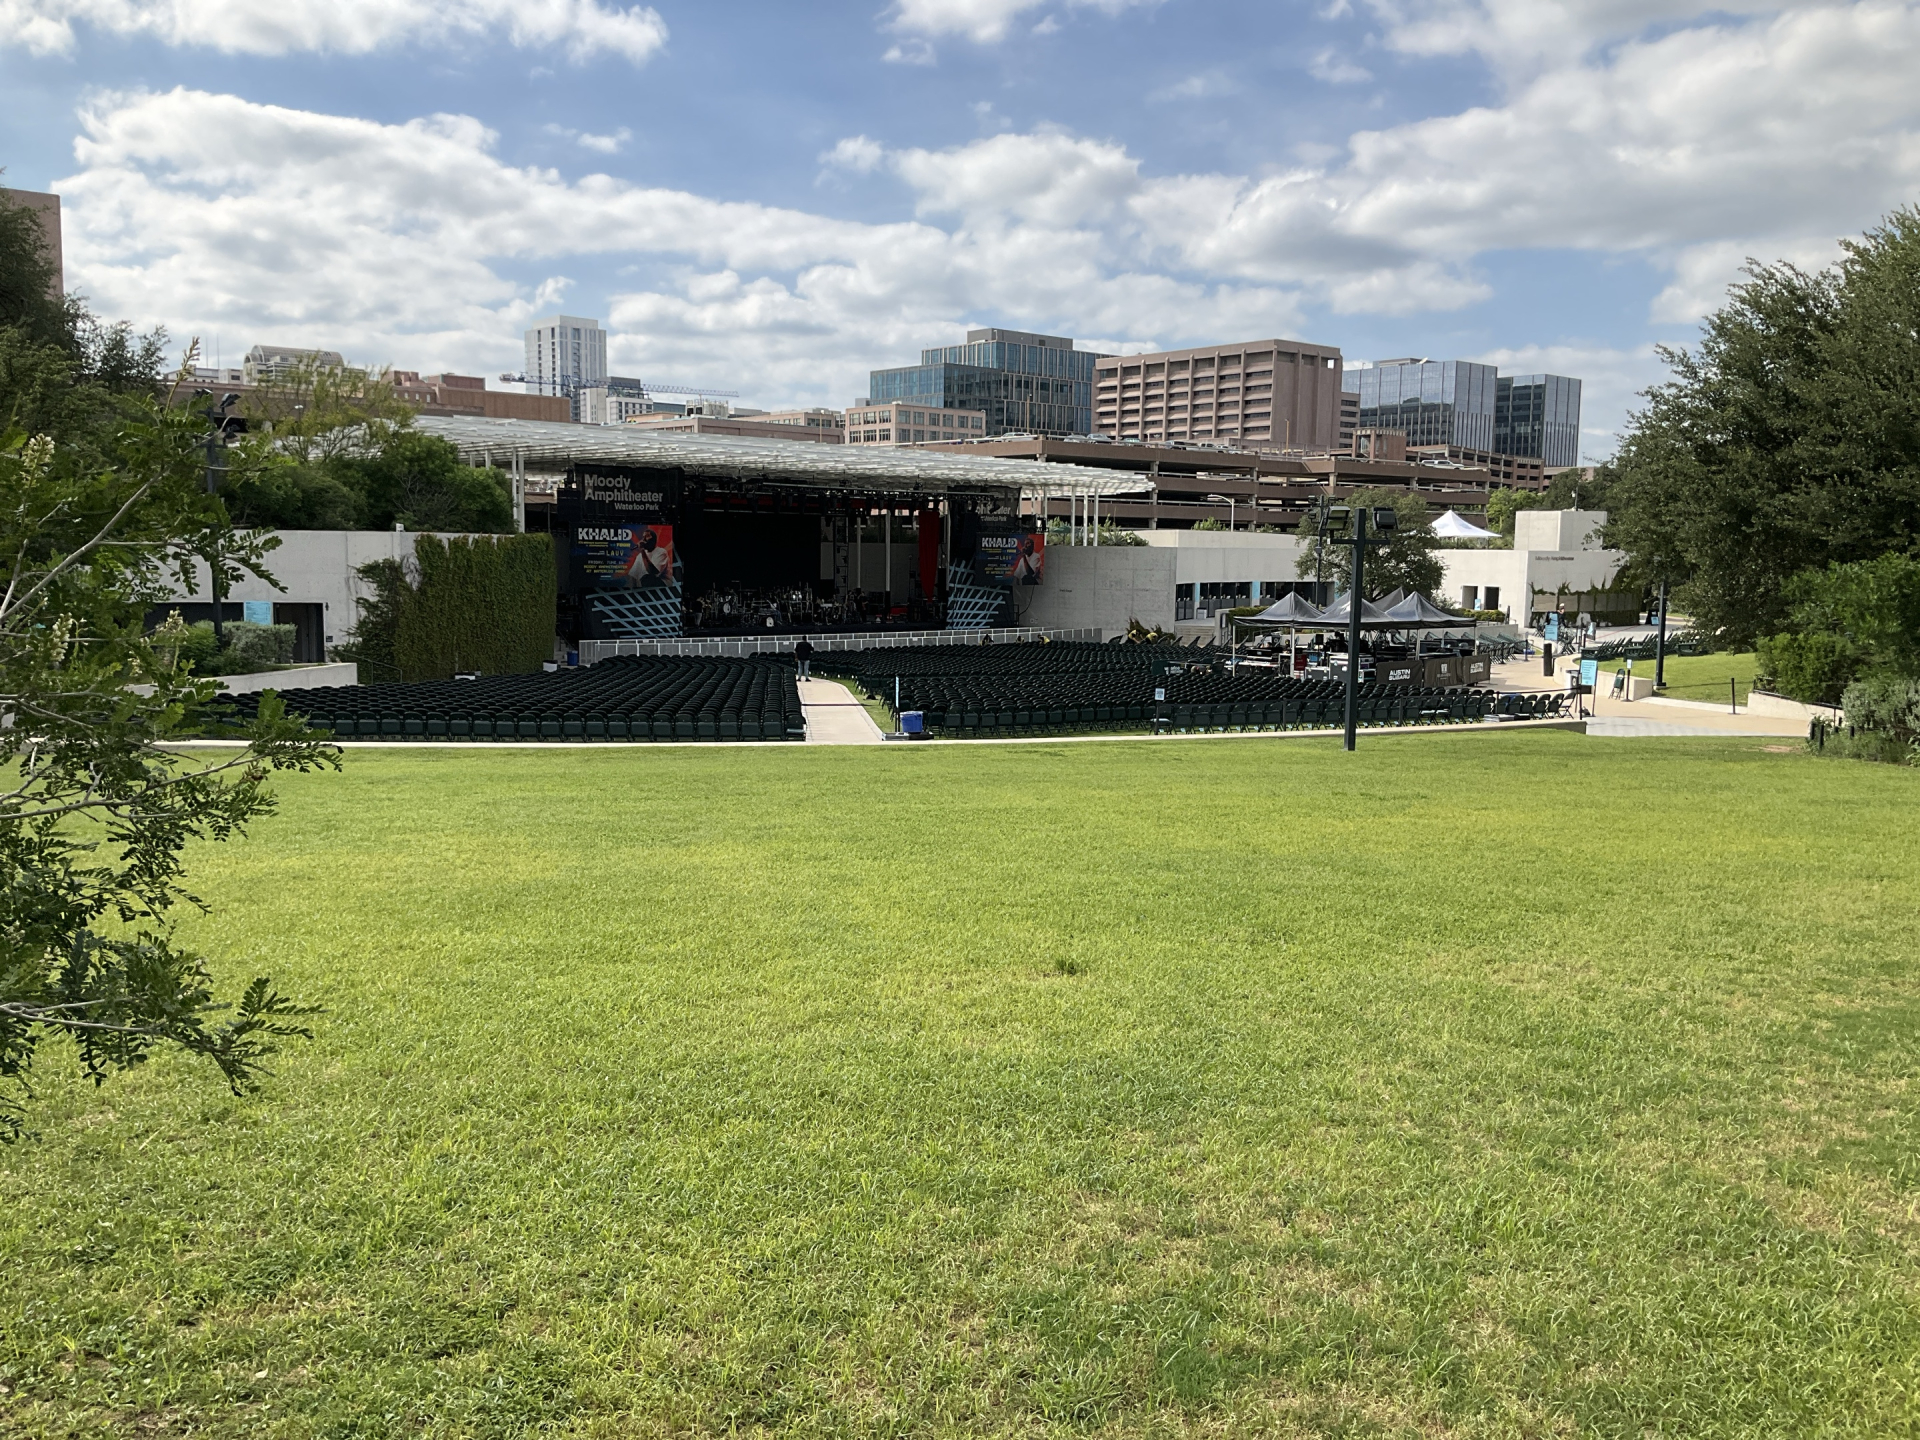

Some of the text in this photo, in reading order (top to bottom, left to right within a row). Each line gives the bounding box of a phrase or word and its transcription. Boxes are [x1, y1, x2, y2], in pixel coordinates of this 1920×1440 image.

[584, 474, 631, 490] Moody
[585, 488, 663, 503] Amphitheater
[614, 502, 659, 511] Waterloo Park
[578, 528, 632, 541] KHALID
[981, 537, 1018, 548] KHALID
[1389, 668, 1411, 676] AUSTIN
